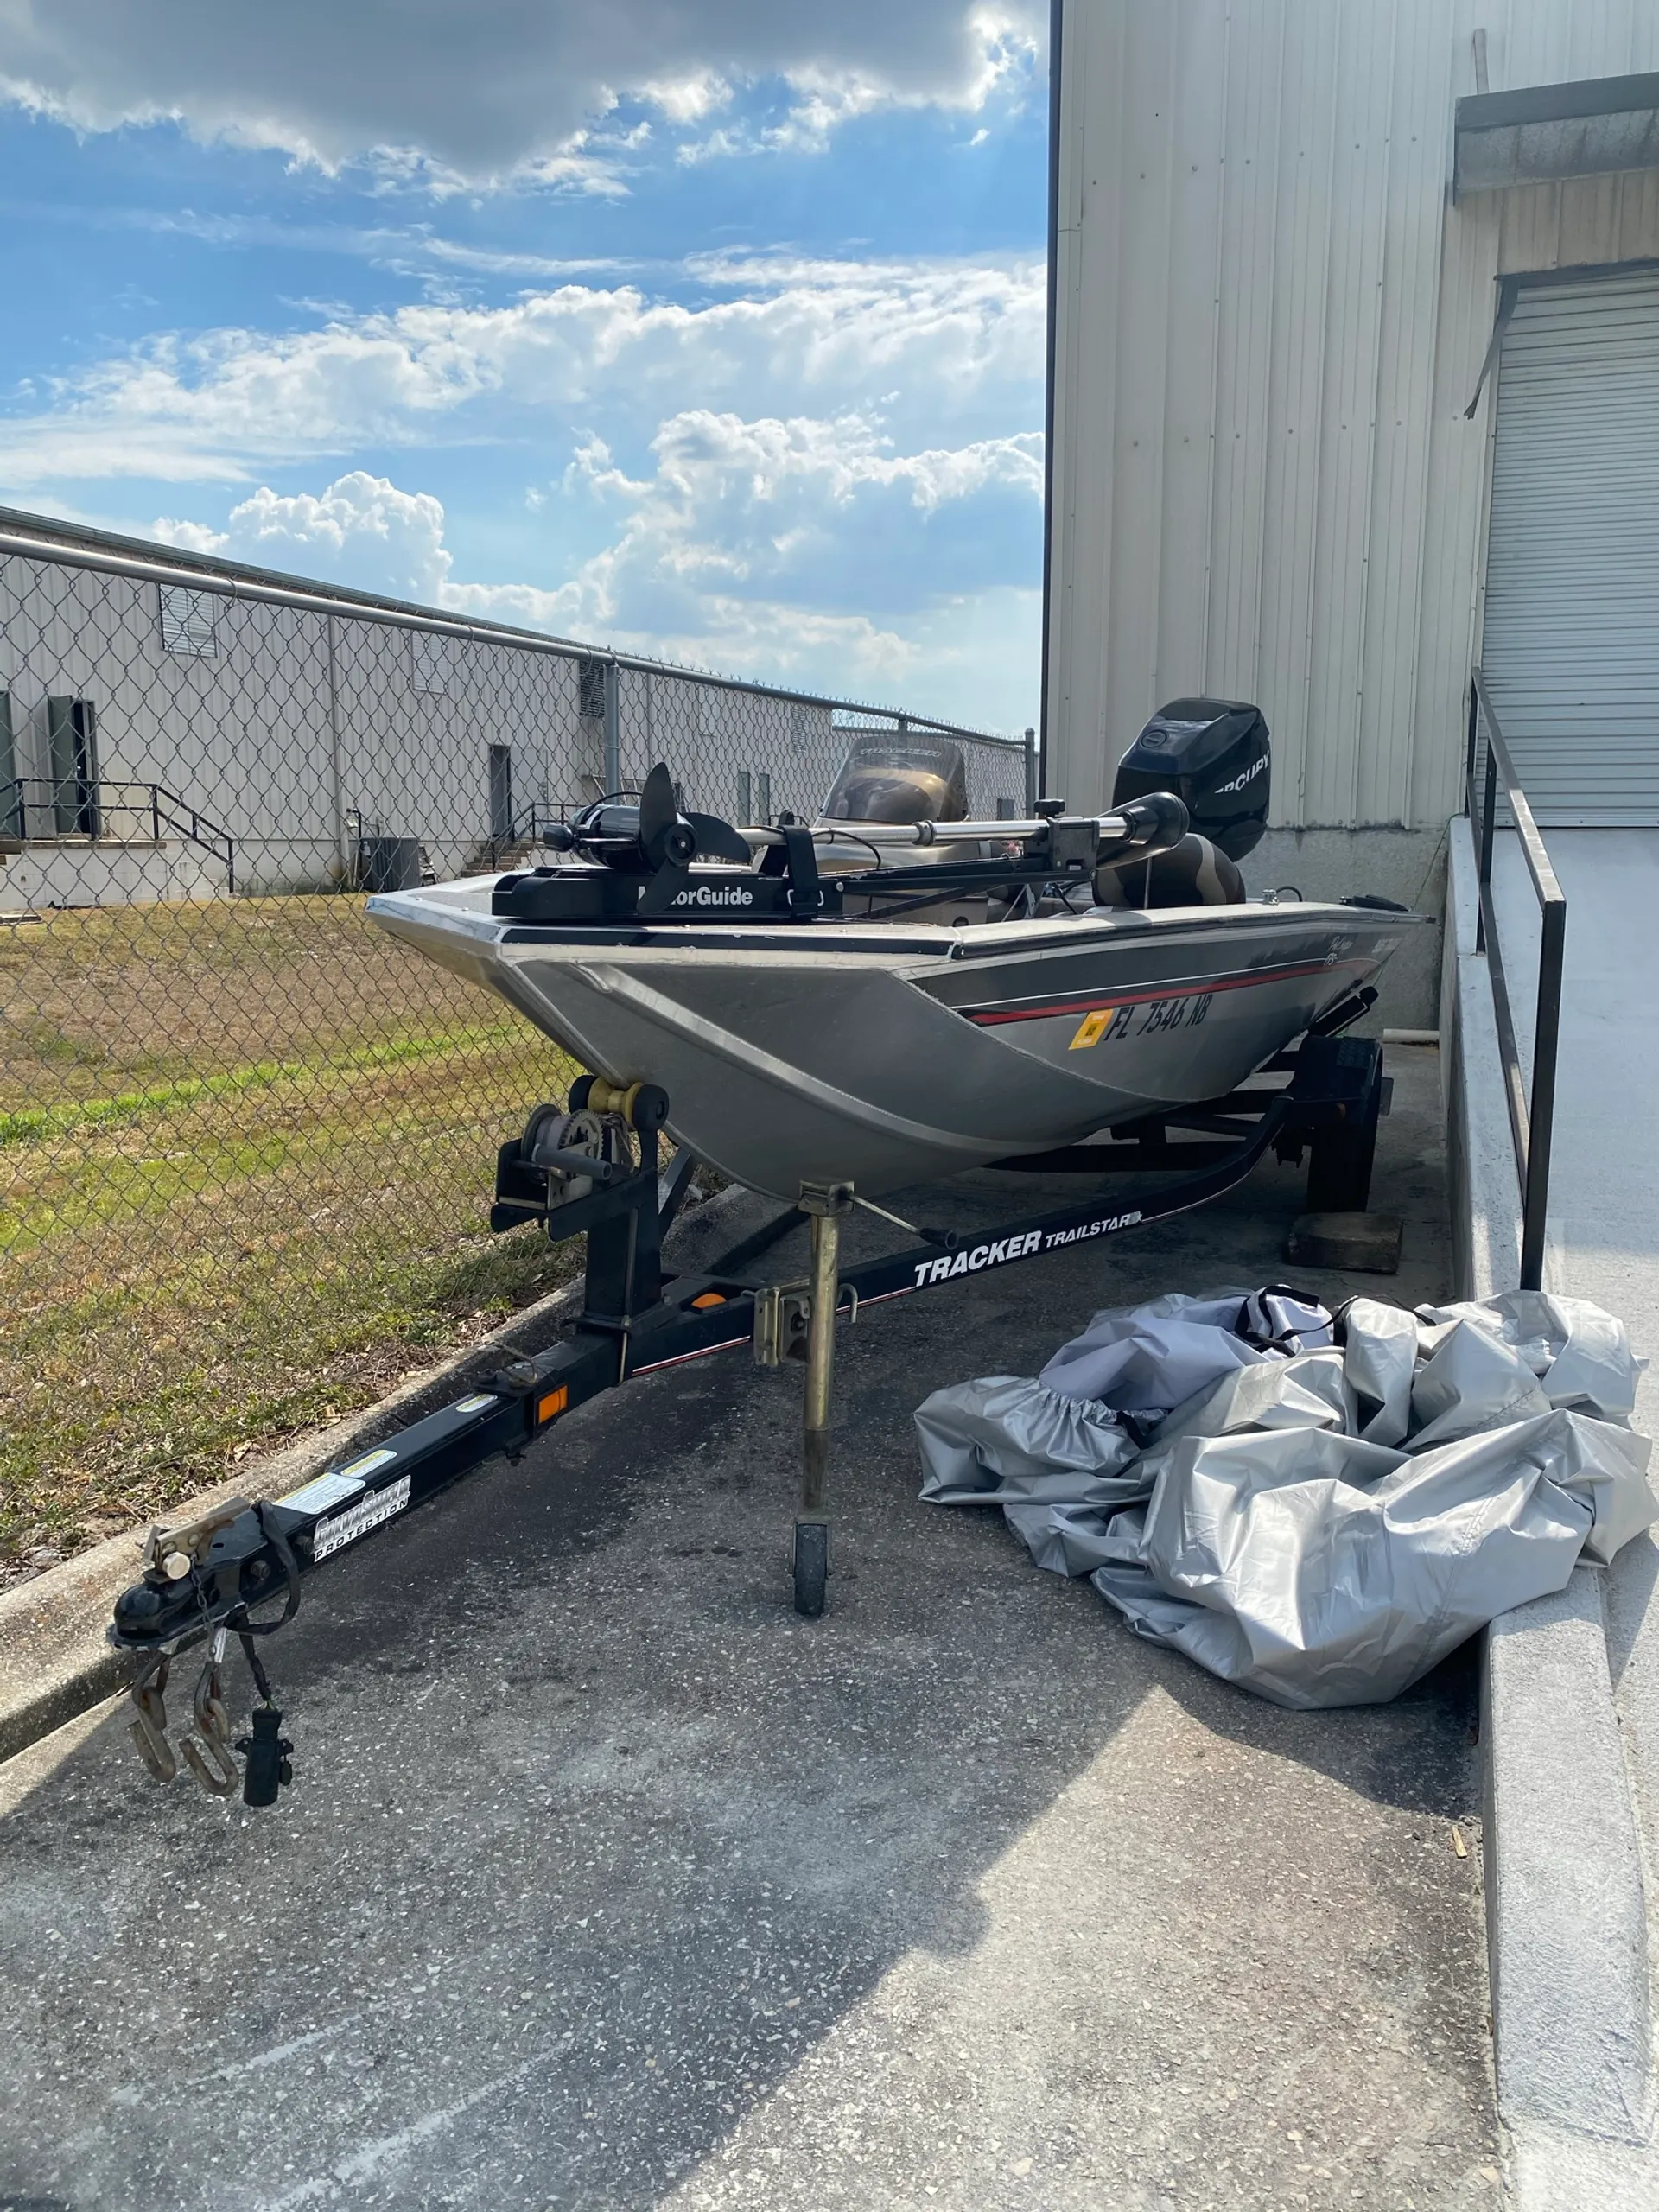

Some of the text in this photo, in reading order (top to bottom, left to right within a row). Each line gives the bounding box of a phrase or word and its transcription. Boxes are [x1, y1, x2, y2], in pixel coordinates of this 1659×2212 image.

[638, 886, 753, 906] orGuide
[1104, 994, 1214, 1041] FL 7546 NB
[914, 1215, 1132, 1287] TRACKER TRAILSTAR
[315, 1498, 408, 1560] PROTECTION
